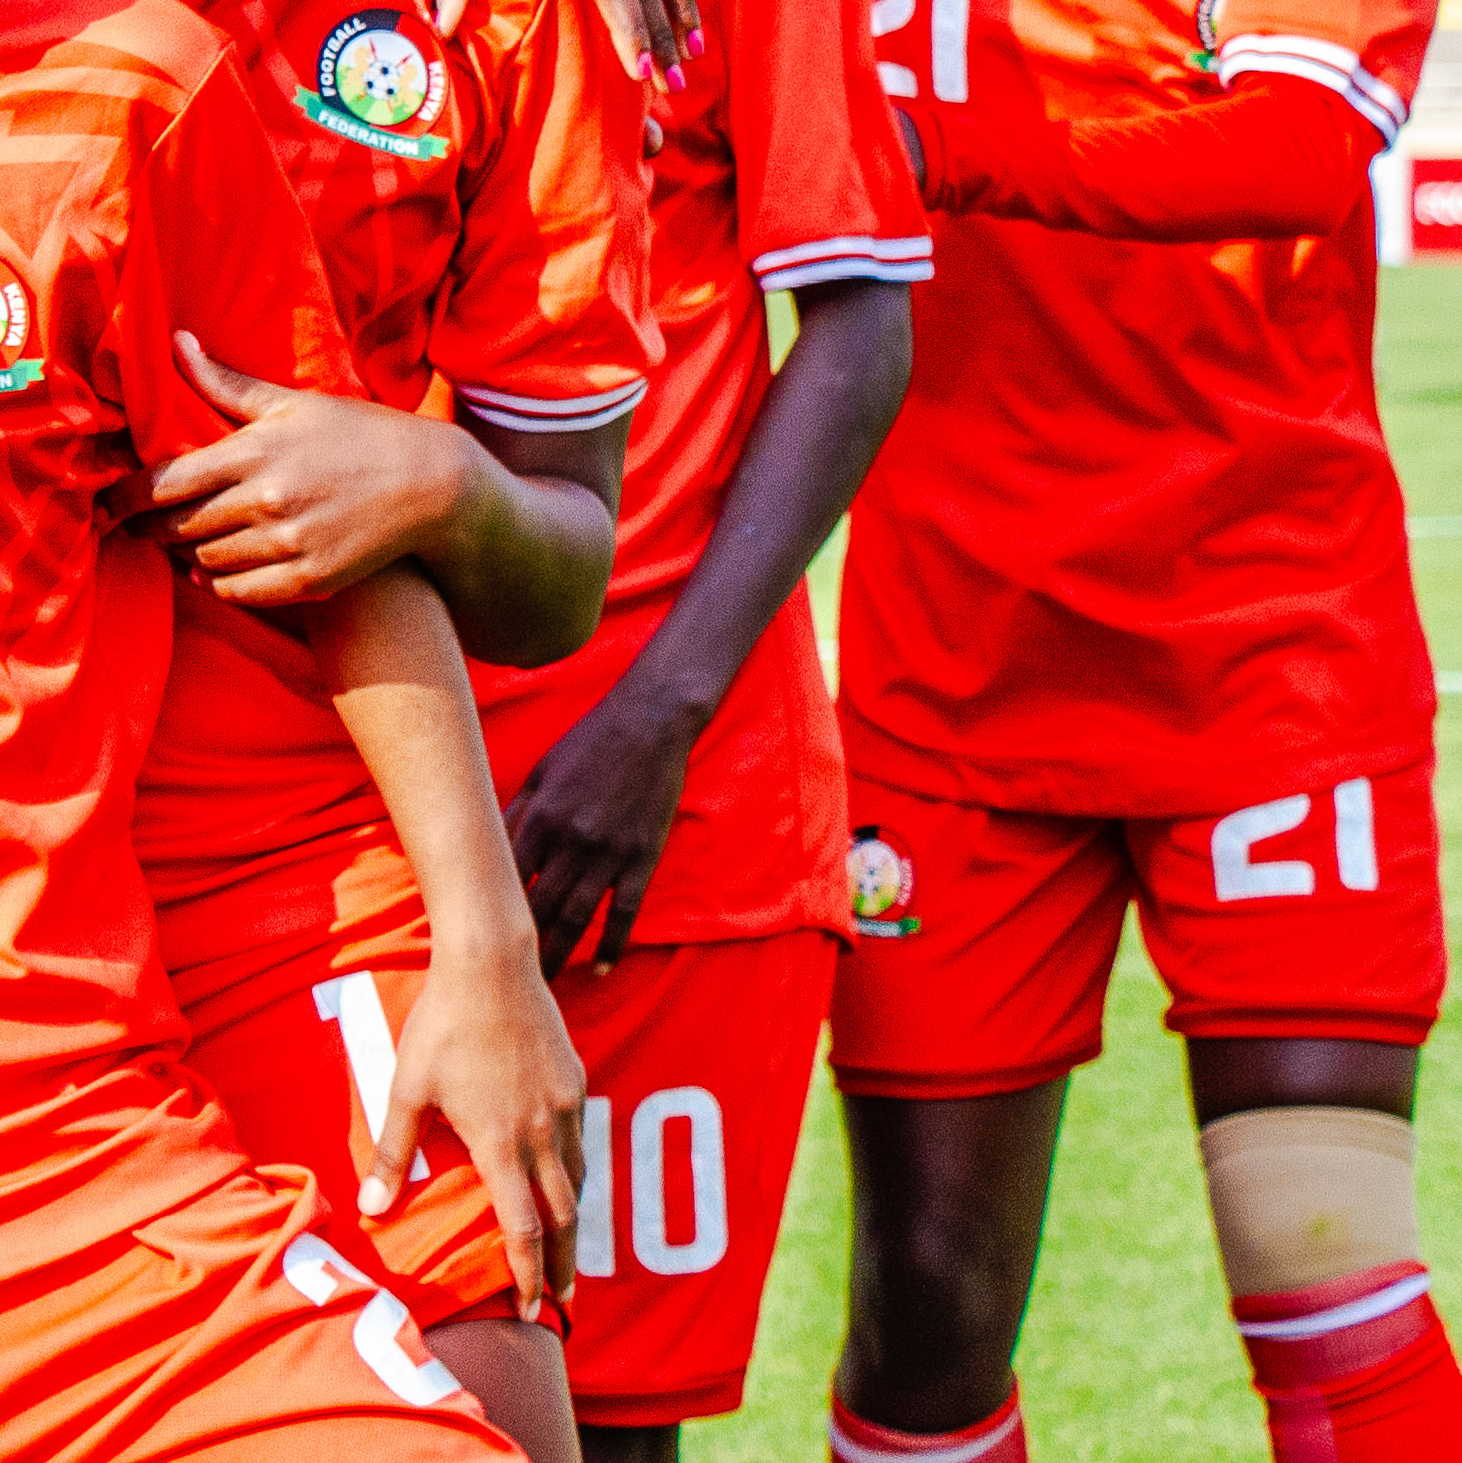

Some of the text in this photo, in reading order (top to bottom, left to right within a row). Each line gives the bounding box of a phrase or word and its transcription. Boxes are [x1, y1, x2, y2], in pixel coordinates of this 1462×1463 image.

[320, 17, 367, 98] FOOTBALL
[417, 60, 445, 122] KENYA
[317, 109, 420, 156] FEDERATION
[4, 282, 26, 346] KENYA
[1211, 776, 1378, 903] 21
[576, 1085, 729, 1278] 10
